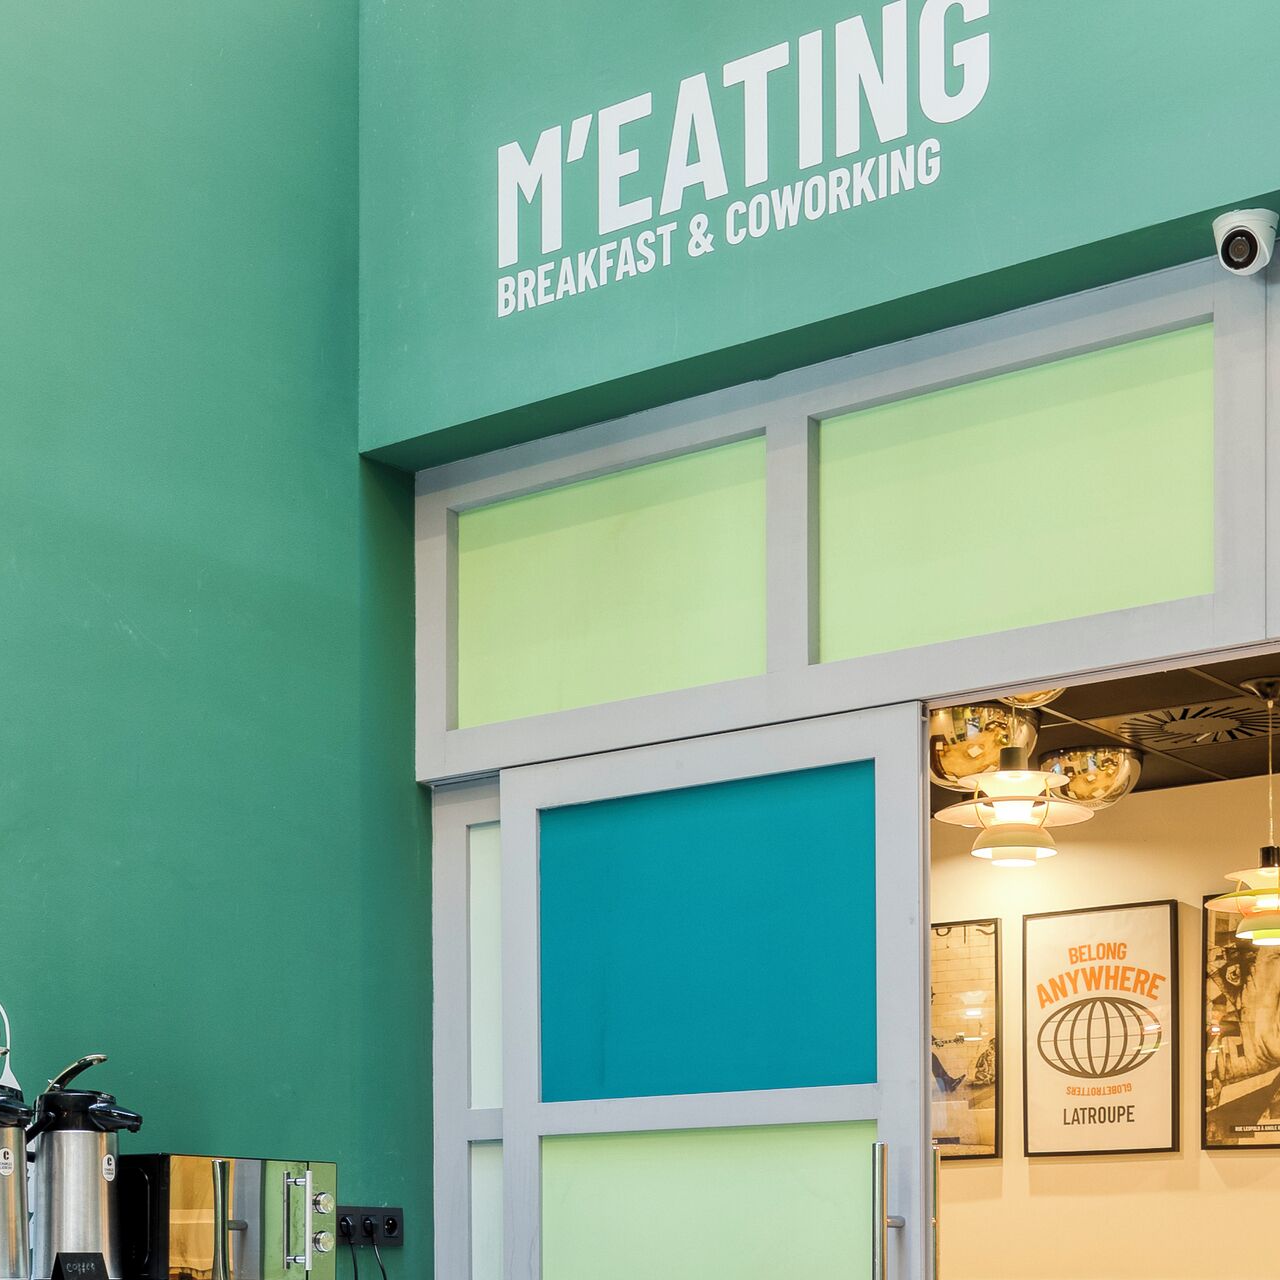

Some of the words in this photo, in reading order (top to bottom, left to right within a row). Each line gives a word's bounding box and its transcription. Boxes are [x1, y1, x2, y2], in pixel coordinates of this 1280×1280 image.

[497, 0, 990, 269] M'EATING
[497, 221, 678, 319] BREAKFAST
[687, 213, 715, 258] &
[726, 138, 942, 246] COWORKING
[1068, 942, 1127, 965] BELONG
[1036, 965, 1166, 1010] ANYWHERE
[1066, 1083, 1133, 1097] GLOBETROTTERS
[1063, 1105, 1135, 1125] LATROUPE
